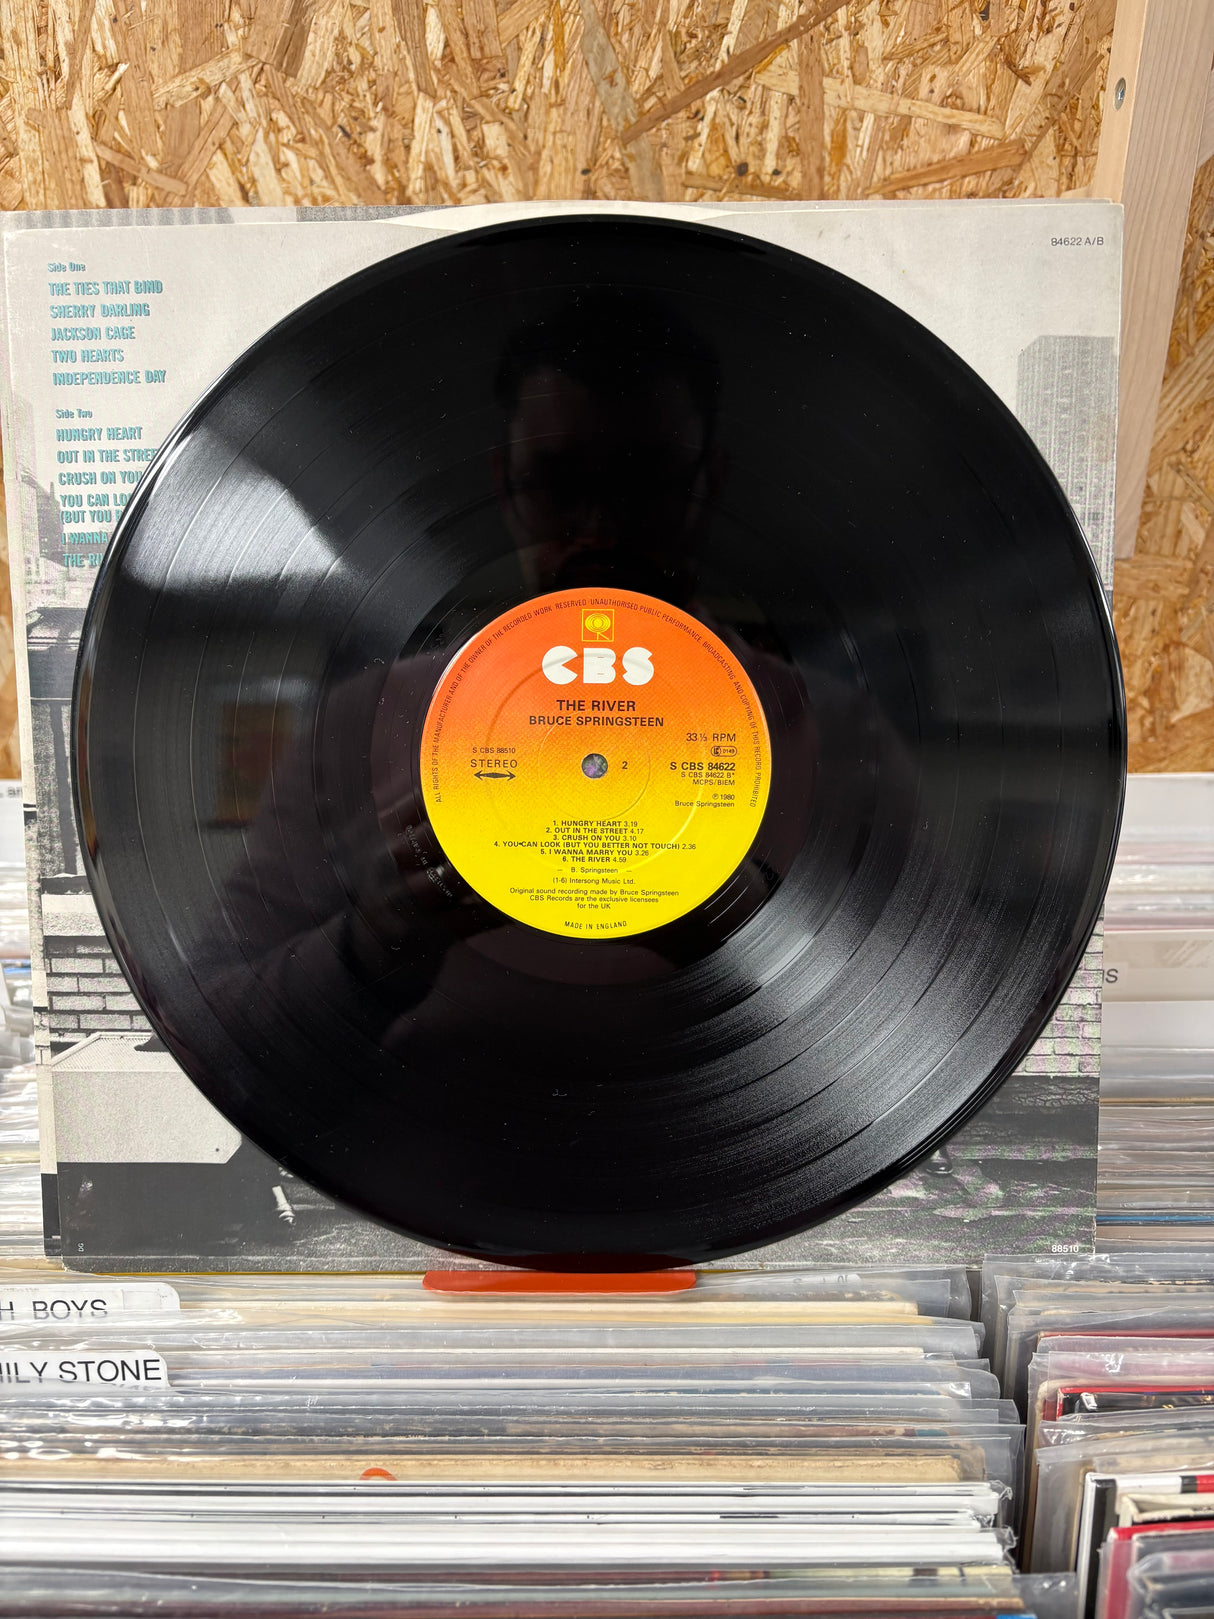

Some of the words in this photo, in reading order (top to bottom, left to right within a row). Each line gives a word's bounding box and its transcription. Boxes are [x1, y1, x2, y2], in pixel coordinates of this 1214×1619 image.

[1050, 237, 1082, 246] 84622
[1084, 236, 1104, 246] A/B
[48, 263, 67, 272] Side
[68, 262, 86, 272] One
[48, 282, 71, 296] THE
[73, 281, 100, 295] TIES
[102, 280, 131, 295] THAT
[134, 280, 163, 294] BIND
[50, 304, 96, 318] SHERRY
[100, 303, 150, 317] DARLING
[51, 327, 101, 341] JACKSON
[105, 326, 136, 340] CAGE
[51, 350, 77, 363] TWO
[81, 349, 124, 363] HEARTS
[52, 371, 141, 385] INDEPENDENCE
[145, 370, 166, 383] DAY
[56, 409, 74, 418] Side
[77, 409, 93, 418] Two
[56, 428, 102, 442] HUNGRY
[106, 426, 143, 440] HEART
[57, 450, 79, 464] OUT
[83, 450, 95, 463] IN
[98, 449, 120, 463] THE
[123, 448, 160, 462] STREE
[58, 472, 97, 485] CRUSH
[100, 471, 116, 485] ON
[119, 470, 142, 484] YOU
[60, 494, 83, 507] YOU
[87, 494, 109, 506] CAN
[59, 510, 86, 524] (BUT
[89, 510, 112, 523] YOU
[61, 533, 66, 545] I
[69, 532, 108, 545] WANNA
[63, 554, 85, 567] THE
[542, 645, 654, 686] CBS
[434, 695, 452, 742] MANUFACTURER
[450, 682, 459, 696] AND
[456, 672, 463, 681] OF
[461, 662, 470, 673] THE
[470, 644, 486, 664] OWNER
[485, 638, 493, 647] OF
[492, 631, 504, 641] THE
[503, 612, 532, 633] RECORDED
[534, 606, 552, 617] WORK
[555, 599, 587, 610] RESERVED
[590, 599, 638, 611] UNAUTHORISED
[639, 604, 662, 618] PUBLIC
[662, 613, 702, 642] PERFORMANCE
[702, 641, 735, 680] BROADCASTING
[733, 681, 744, 695] AND
[740, 694, 754, 720] COPYING
[750, 772, 761, 808] PROHIBITED
[556, 700, 585, 711] THE
[591, 700, 636, 712] RIVER
[529, 715, 572, 726] BRUCE
[576, 716, 664, 727] SPRINGSTEEN
[712, 733, 736, 742] RPM
[470, 759, 518, 768] STEREO
[622, 761, 628, 770] 2
[670, 762, 677, 770] S
[681, 762, 704, 770] CBS
[708, 762, 736, 771] 84622
[564, 921, 582, 929] MADE
[597, 921, 626, 929] ENGLAND
[1051, 1245, 1079, 1253] 88510
[32, 1299, 108, 1320] BOYS
[0, 1362, 48, 1384] ILY
[59, 1359, 162, 1382] STONE
